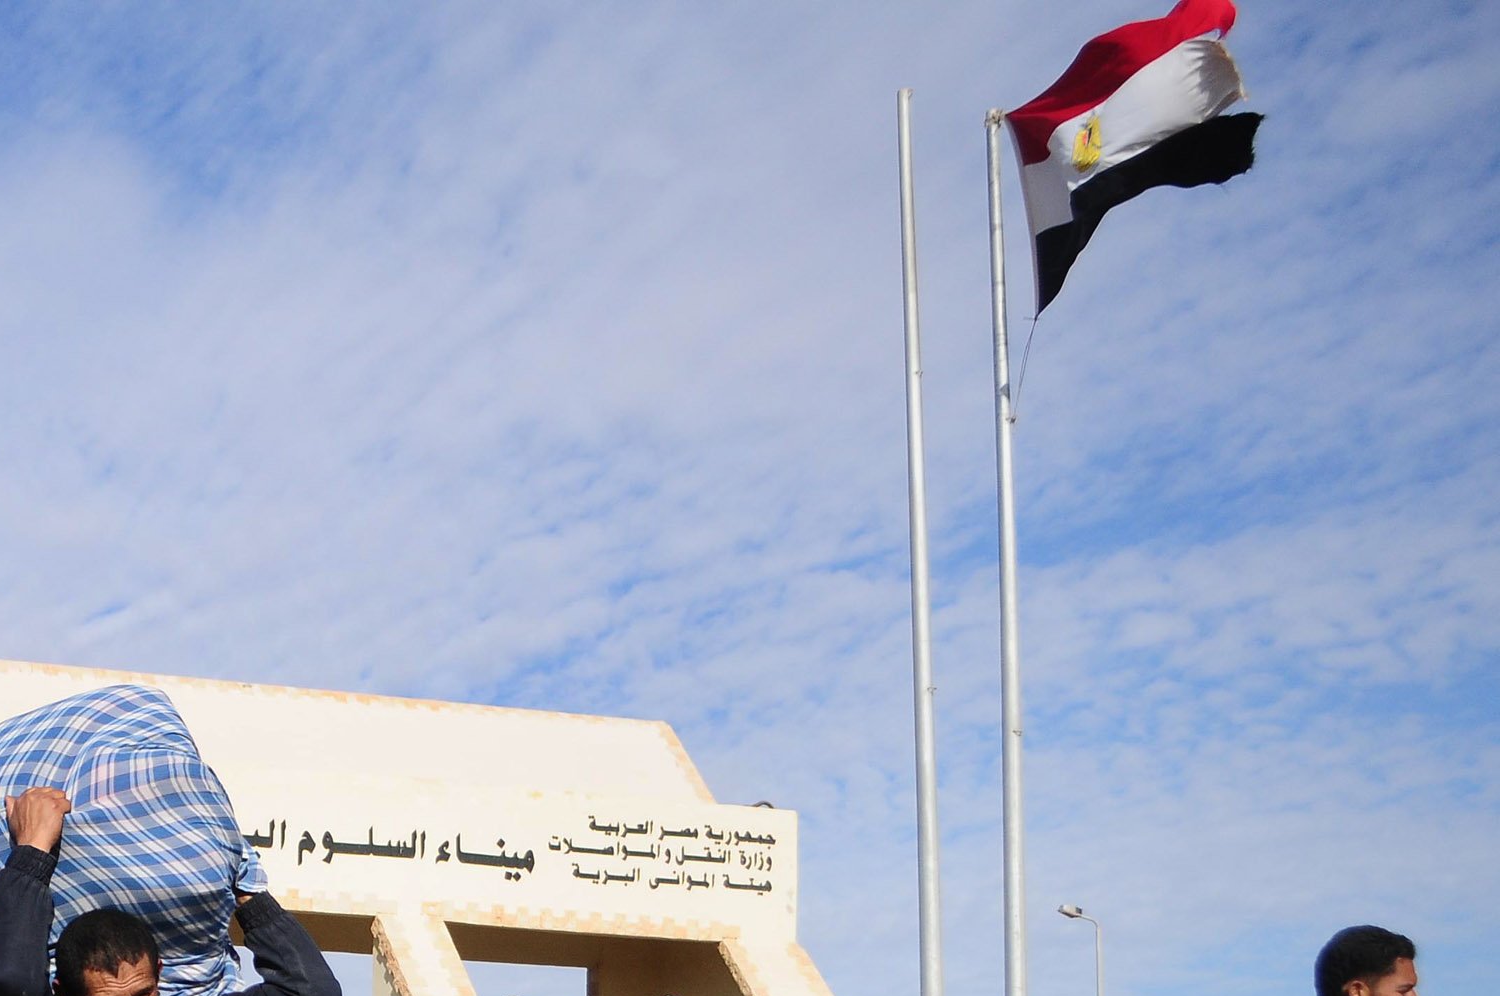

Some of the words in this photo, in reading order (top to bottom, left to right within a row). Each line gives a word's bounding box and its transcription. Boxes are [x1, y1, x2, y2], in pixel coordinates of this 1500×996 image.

[588, 815, 654, 838] العربية
[658, 826, 699, 841] مصر
[704, 824, 777, 850] جمهورية
[297, 826, 426, 866] السلوم
[435, 833, 536, 882] ميناء
[675, 845, 731, 866] النقل
[739, 850, 773, 872] وزارة
[571, 862, 641, 887] البرية
